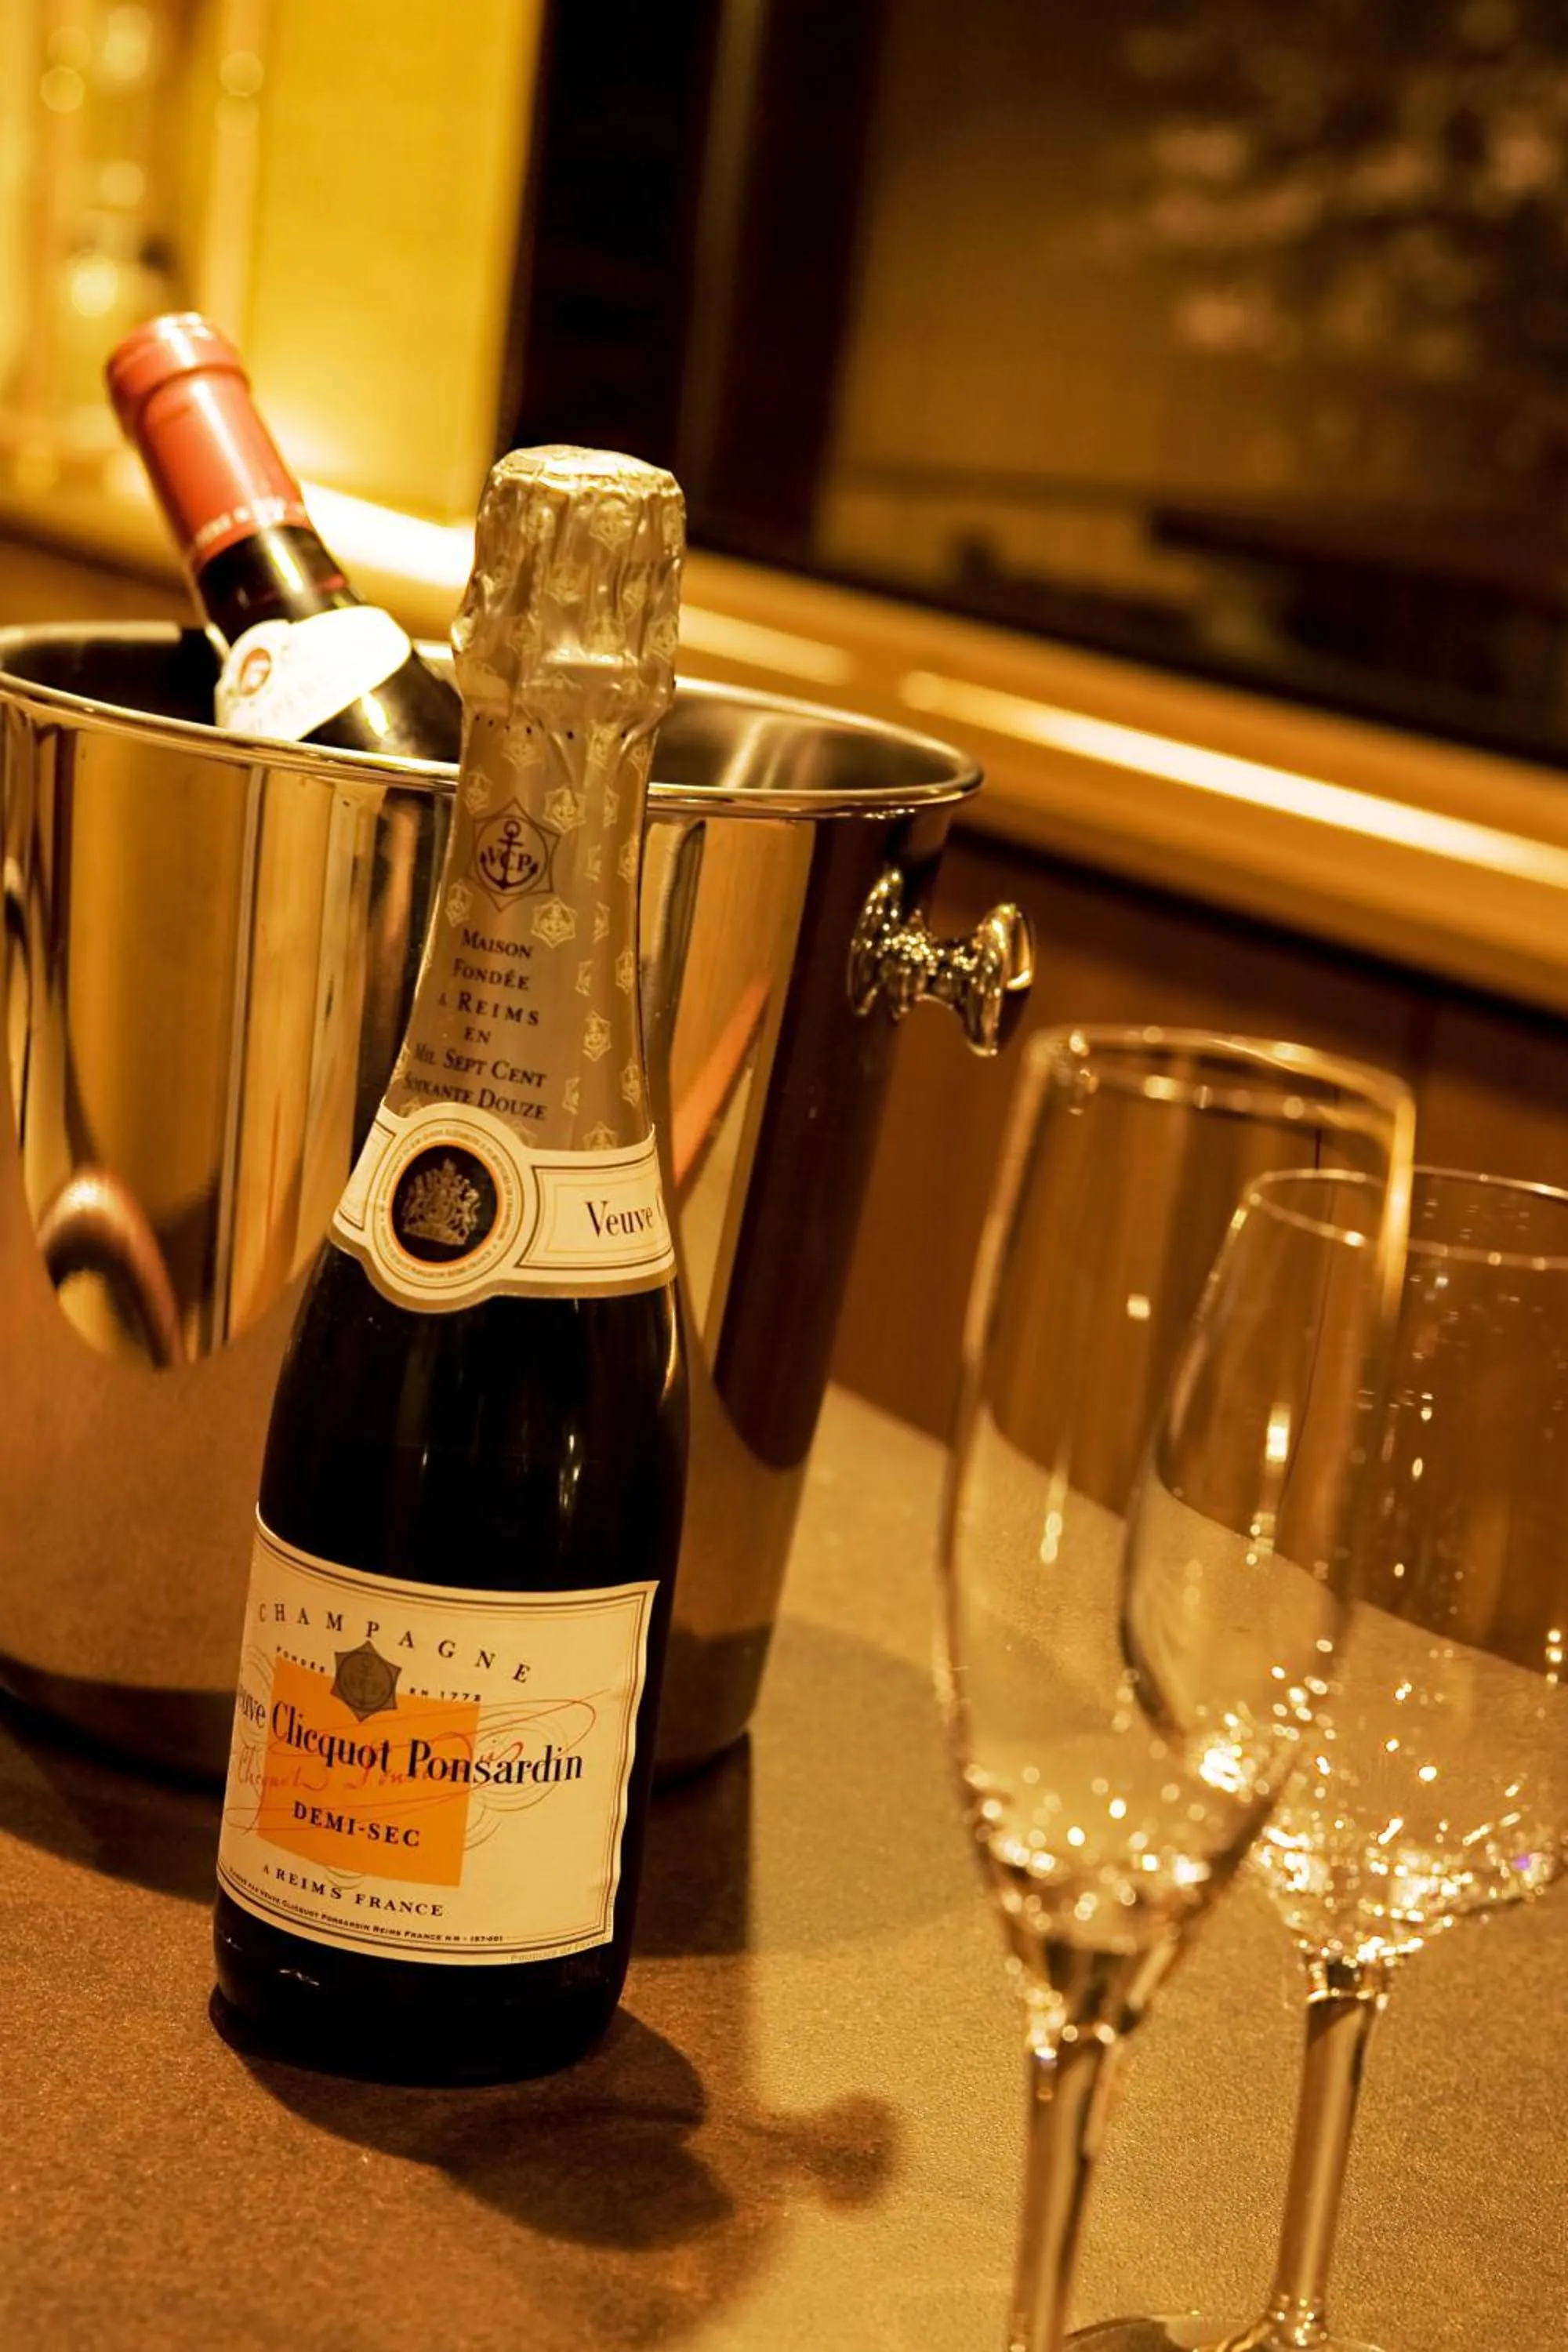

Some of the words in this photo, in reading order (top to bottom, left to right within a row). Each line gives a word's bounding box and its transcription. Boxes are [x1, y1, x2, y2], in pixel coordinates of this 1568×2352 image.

[462, 928, 533, 960] MAISON
[458, 990, 539, 1026] REIMS
[464, 1026, 491, 1045] EN
[442, 1047, 487, 1076] SEPT
[491, 1059, 547, 1088] CENT
[477, 1087, 548, 1121] DOUZE
[584, 1200, 654, 1238] Veuve
[259, 1603, 531, 1683] CHAMPAGNE
[272, 1700, 390, 1775] Clicquot
[407, 1738, 583, 1784] Ponsardin
[293, 1801, 420, 1848] DEMI-SEC
[275, 1867, 343, 1900] REIMS
[354, 1893, 443, 1917] FRANCE
